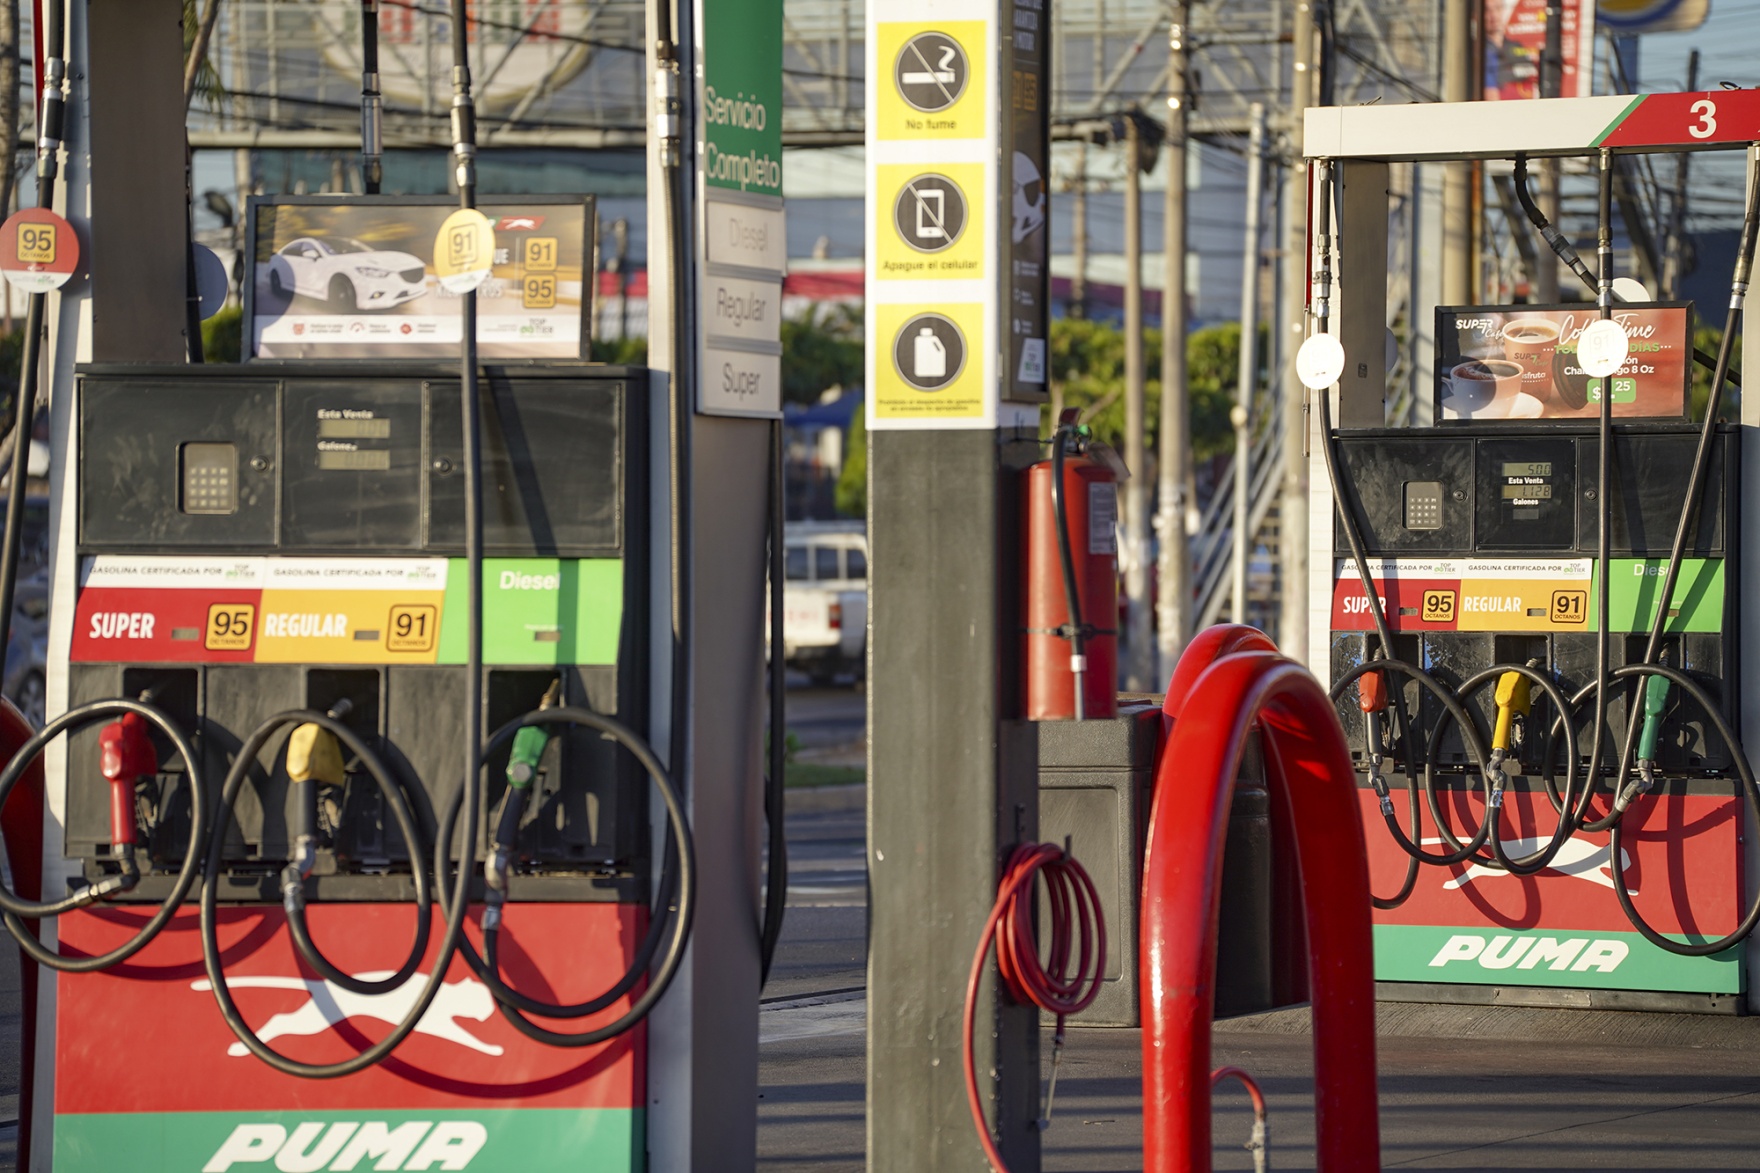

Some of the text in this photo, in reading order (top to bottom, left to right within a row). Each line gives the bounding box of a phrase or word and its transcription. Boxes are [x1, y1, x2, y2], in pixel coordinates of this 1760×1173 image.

[705, 85, 766, 131] Servicio
[906, 119, 957, 130] No fume
[1688, 99, 1717, 139] 3
[706, 142, 780, 191] Completo
[22, 228, 52, 252] 95
[453, 231, 472, 254] 91
[729, 217, 768, 251] Diesel
[530, 242, 551, 262] 91
[883, 260, 978, 272] Apague el celular
[527, 280, 552, 299] 95
[716, 287, 767, 328] Regular
[1613, 312, 1657, 339] Time
[1629, 340, 1661, 353] DÍAS
[1631, 365, 1639, 374] 8
[1640, 365, 1655, 374] Oz
[722, 361, 761, 401] Super
[1508, 477, 1544, 485] Esta Venta
[1512, 498, 1539, 506] Galones
[89, 566, 222, 575] GASOLINA CERTIFICADA POR
[274, 567, 404, 577] GASOLINA CERTIFICADA POR
[1633, 563, 1670, 576] Dies
[499, 570, 562, 591] Diesel
[1342, 596, 1387, 614] SUPR
[1427, 594, 1452, 613] 95
[1463, 596, 1522, 612] REGULAR
[1556, 595, 1580, 614] 91
[88, 612, 156, 639] SUPER
[214, 611, 249, 636] 95
[264, 613, 348, 638] REGULAR
[396, 612, 426, 637] 91
[1428, 934, 1630, 973] PUMA
[201, 1121, 488, 1173] PUMA
